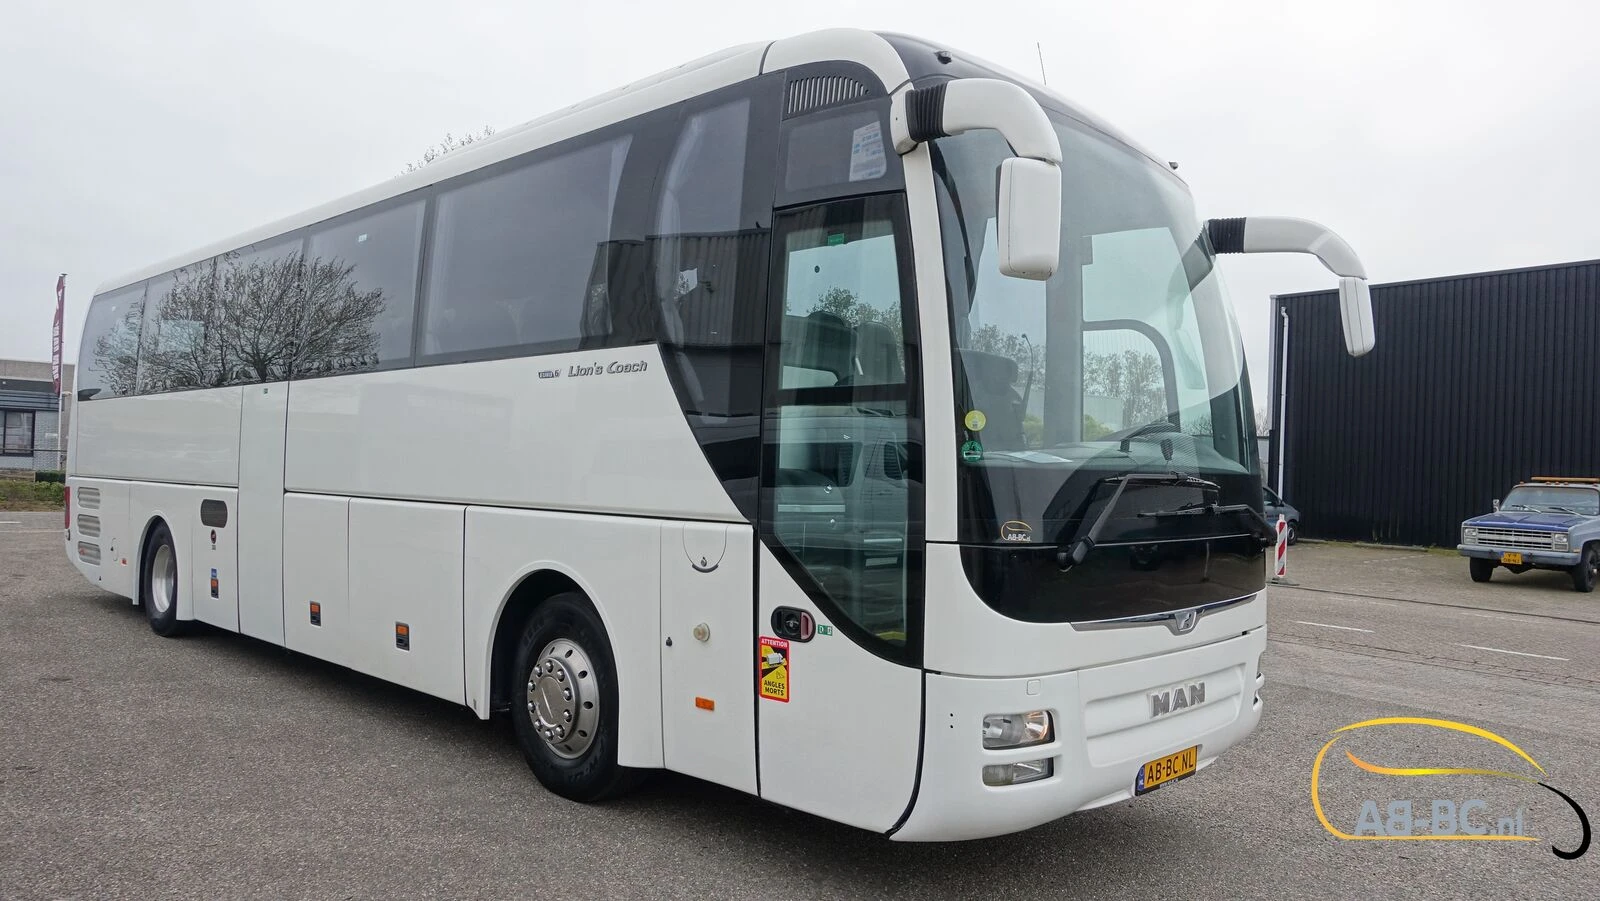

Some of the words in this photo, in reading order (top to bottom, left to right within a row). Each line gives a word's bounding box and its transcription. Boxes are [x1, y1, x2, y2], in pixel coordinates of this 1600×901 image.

[568, 362, 603, 377] Lion's
[607, 360, 648, 374] Coach
[761, 638, 788, 648] ATTENTION
[764, 680, 785, 690] ANGLES
[765, 687, 784, 696] MORTS
[1150, 682, 1206, 718] MAN
